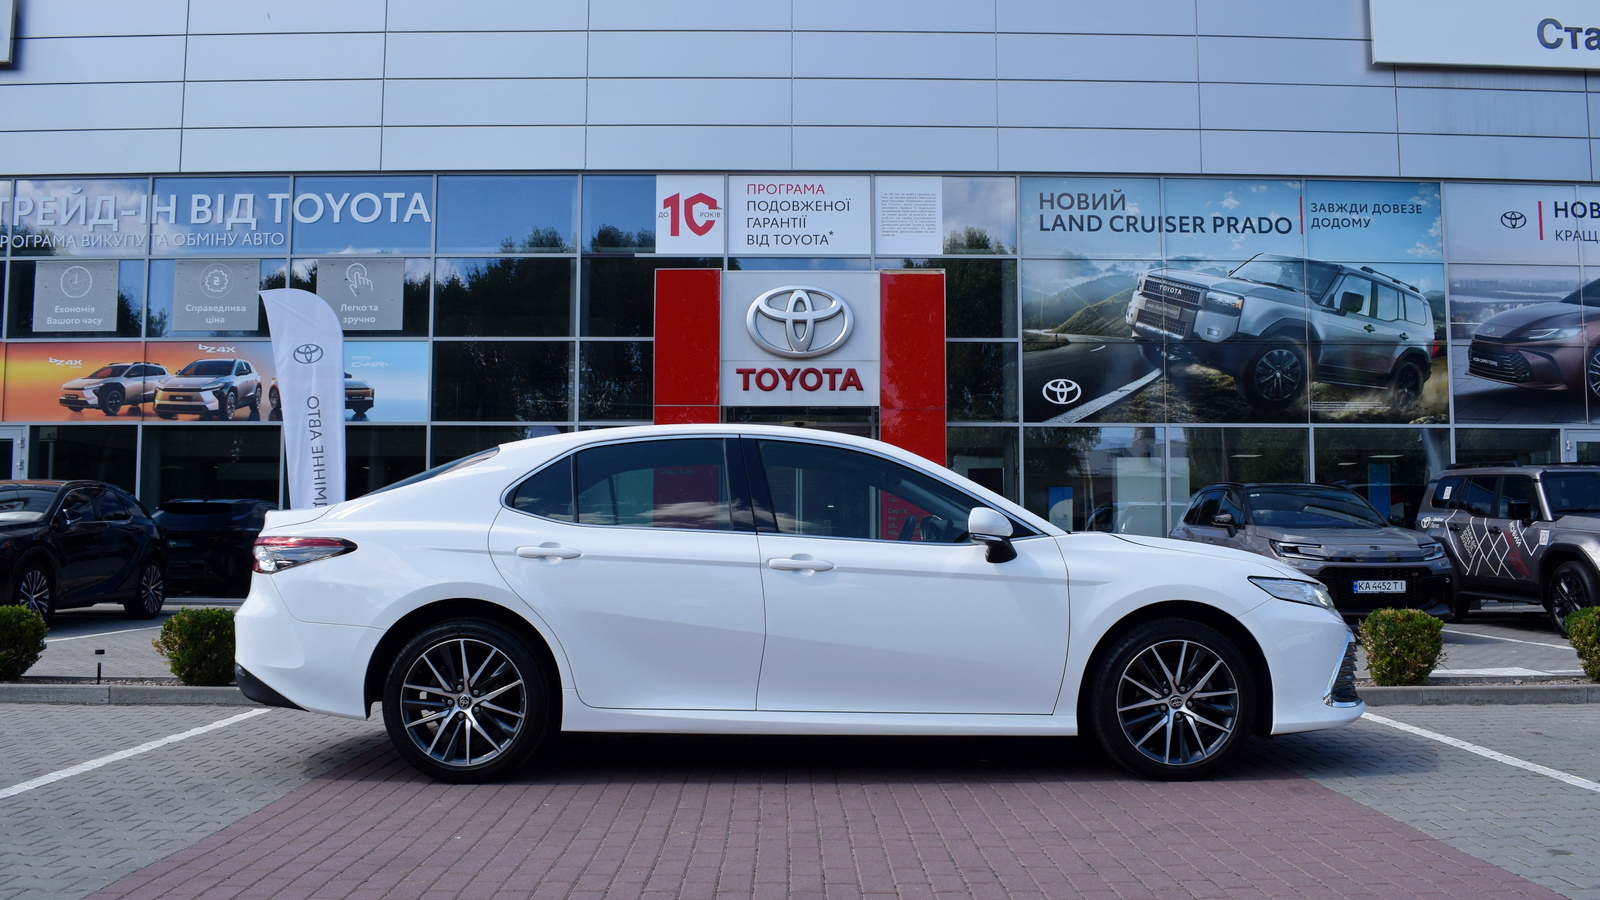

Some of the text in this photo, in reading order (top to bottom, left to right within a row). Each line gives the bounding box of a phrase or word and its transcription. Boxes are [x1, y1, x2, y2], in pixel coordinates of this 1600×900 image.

[1537, 17, 1600, 50] Ста
[747, 183, 825, 195] ПРОГРАМА
[747, 198, 851, 214] ПОДОВЖЕНОЇ
[1039, 189, 1126, 211] НОВИЙ
[190, 193, 257, 231] ВІД
[268, 192, 432, 225] TOYOTA
[1310, 202, 1422, 215] ЗАВЖДИ ДОВЕЗЕ
[1554, 201, 1600, 219] НОВ
[747, 214, 807, 228] ГАРАНТІЇ
[1039, 214, 1293, 234] LAND CRUISER PRADO
[1311, 217, 1371, 230] ДОДОМУ
[81, 233, 146, 248] ВИКУПУ
[150, 233, 169, 248] ТА
[173, 233, 238, 247] ОБМІНУ
[241, 232, 285, 246] АВТО
[747, 234, 770, 247] ВІД
[1555, 229, 1600, 245] КРАЩ
[1159, 284, 1182, 295] TOYOTA
[54, 305, 96, 314] Економія
[185, 304, 246, 314] Справедлива
[340, 303, 367, 312] Легко
[47, 316, 102, 326] Вашого часу
[205, 315, 225, 325] ціна
[342, 316, 376, 325] зручно
[736, 368, 864, 392] TOYOTA
[1358, 582, 1371, 590] KA
[1372, 582, 1391, 590] 4452
